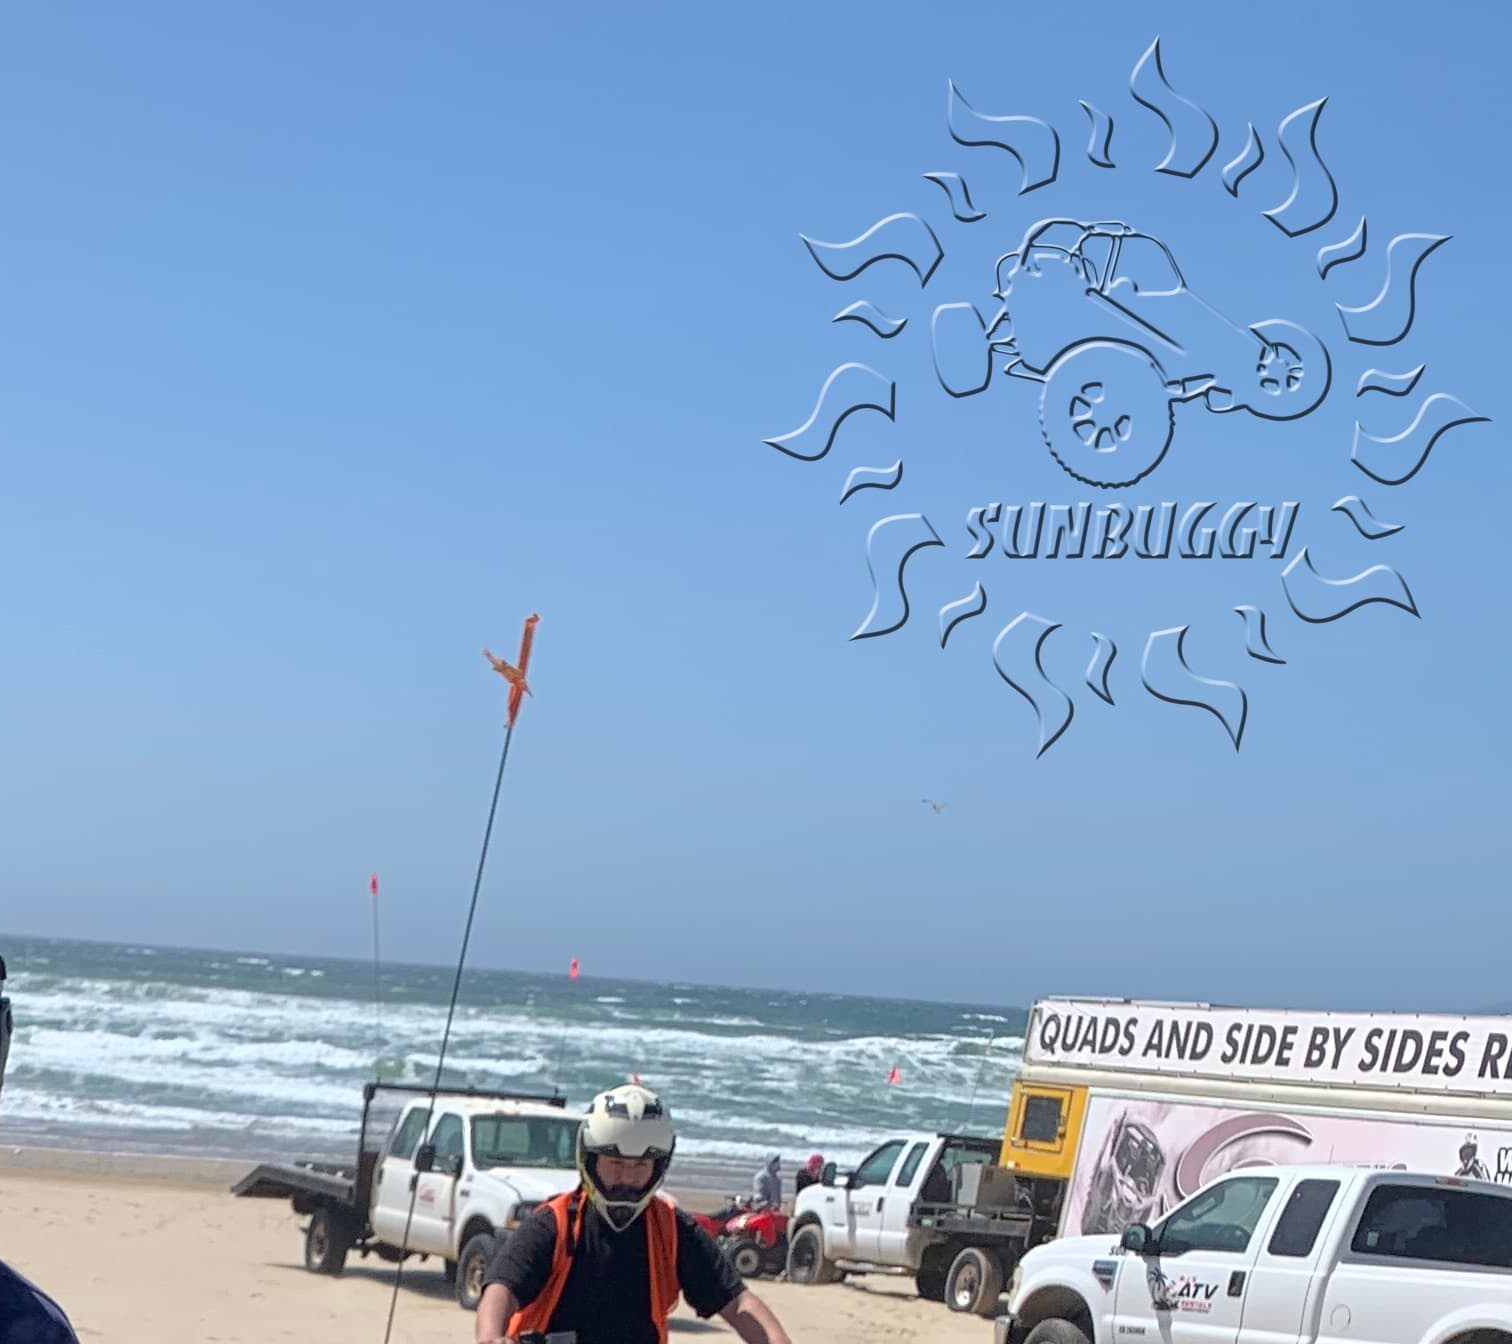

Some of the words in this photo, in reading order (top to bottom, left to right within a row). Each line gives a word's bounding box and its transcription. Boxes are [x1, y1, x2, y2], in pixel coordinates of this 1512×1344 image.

[1039, 1013, 1139, 1057] QUADS
[1141, 1019, 1214, 1061] AND
[1220, 1022, 1299, 1067] SIDE
[1303, 1026, 1356, 1070] BY
[1357, 1027, 1471, 1077] SIDES
[1178, 1282, 1219, 1299] ATV
